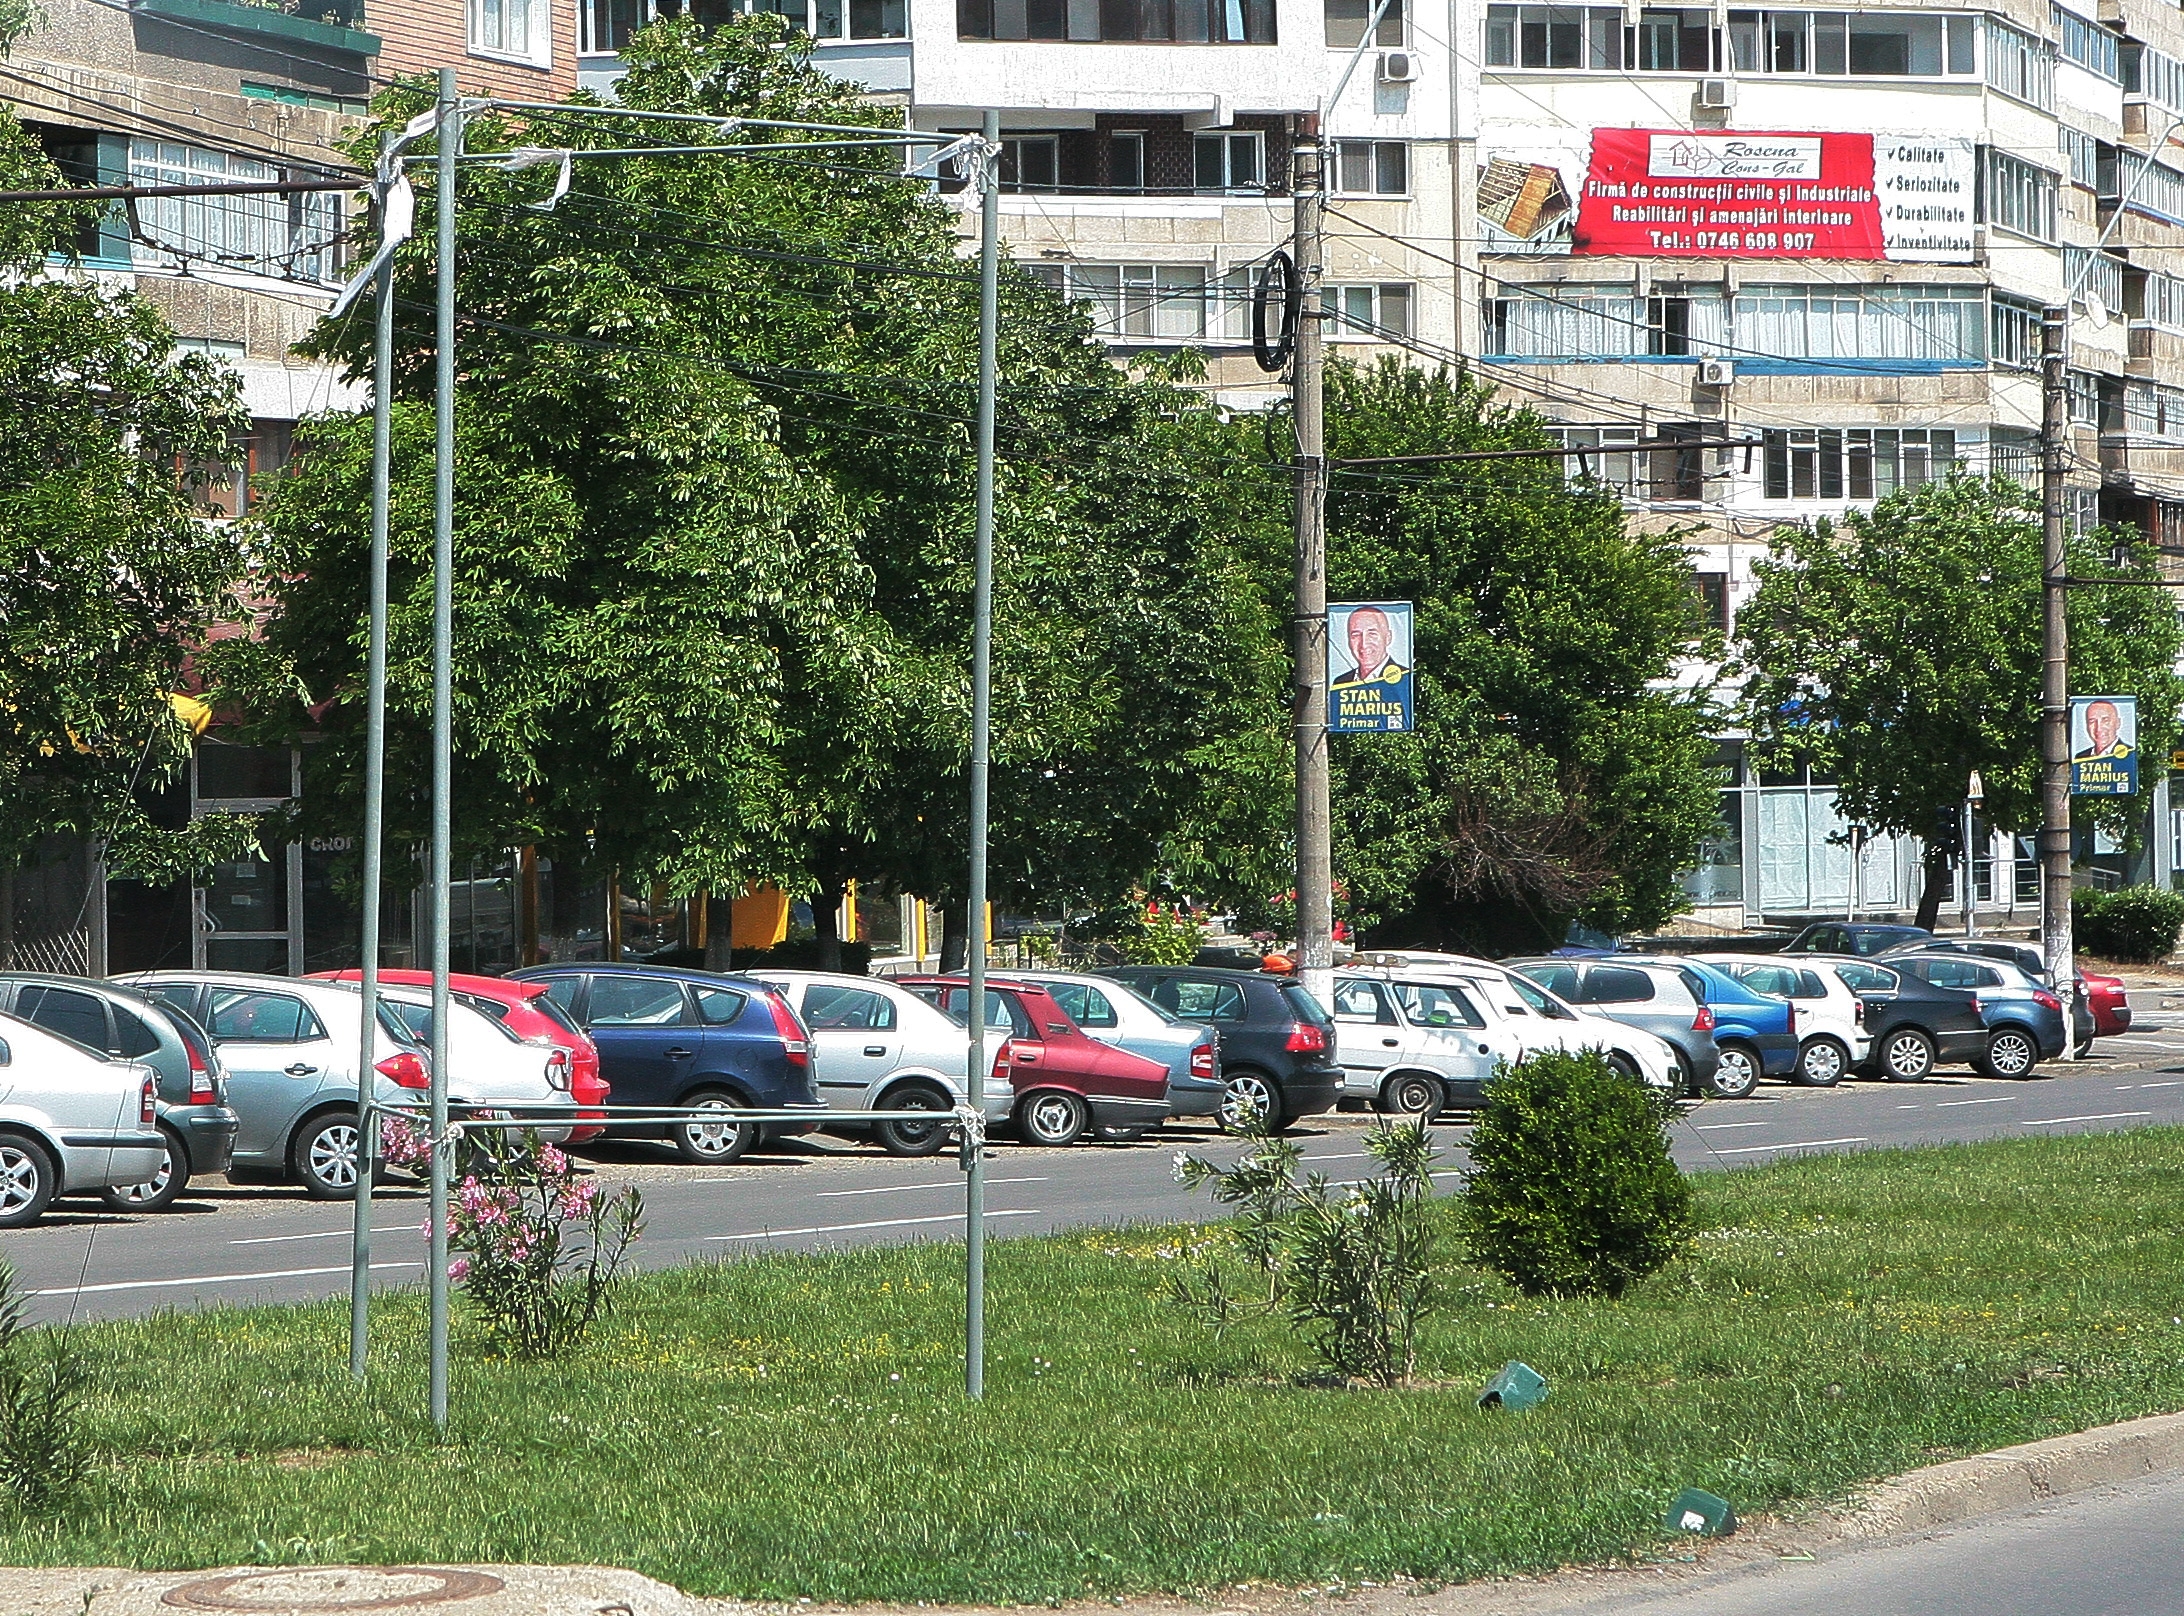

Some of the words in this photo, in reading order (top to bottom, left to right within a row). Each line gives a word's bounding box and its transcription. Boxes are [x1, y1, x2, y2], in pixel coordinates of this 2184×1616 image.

[1898, 145, 1945, 163] Calitate
[1588, 180, 1627, 198] Firmă
[1631, 181, 1648, 198] de
[1736, 183, 1774, 200] civile
[1796, 184, 1871, 202] industriale
[1897, 175, 1960, 193] Seriozitate
[1612, 205, 1687, 223] Reabilitări
[1709, 207, 1778, 228] amenajări
[1783, 208, 1852, 226] interioare
[1896, 205, 1965, 222] Durabilitate
[1650, 231, 1691, 249] Tel.:
[1697, 231, 1740, 249] 0746
[1745, 232, 1777, 250] 608
[1783, 232, 1815, 250] 907
[1897, 233, 1970, 251] Inventivitate
[1340, 689, 1380, 702] STAN
[1340, 702, 1402, 715] MARIUS
[1340, 718, 1380, 728] Primar
[2081, 763, 2111, 772] STAN
[2081, 772, 2128, 782] MARIUS
